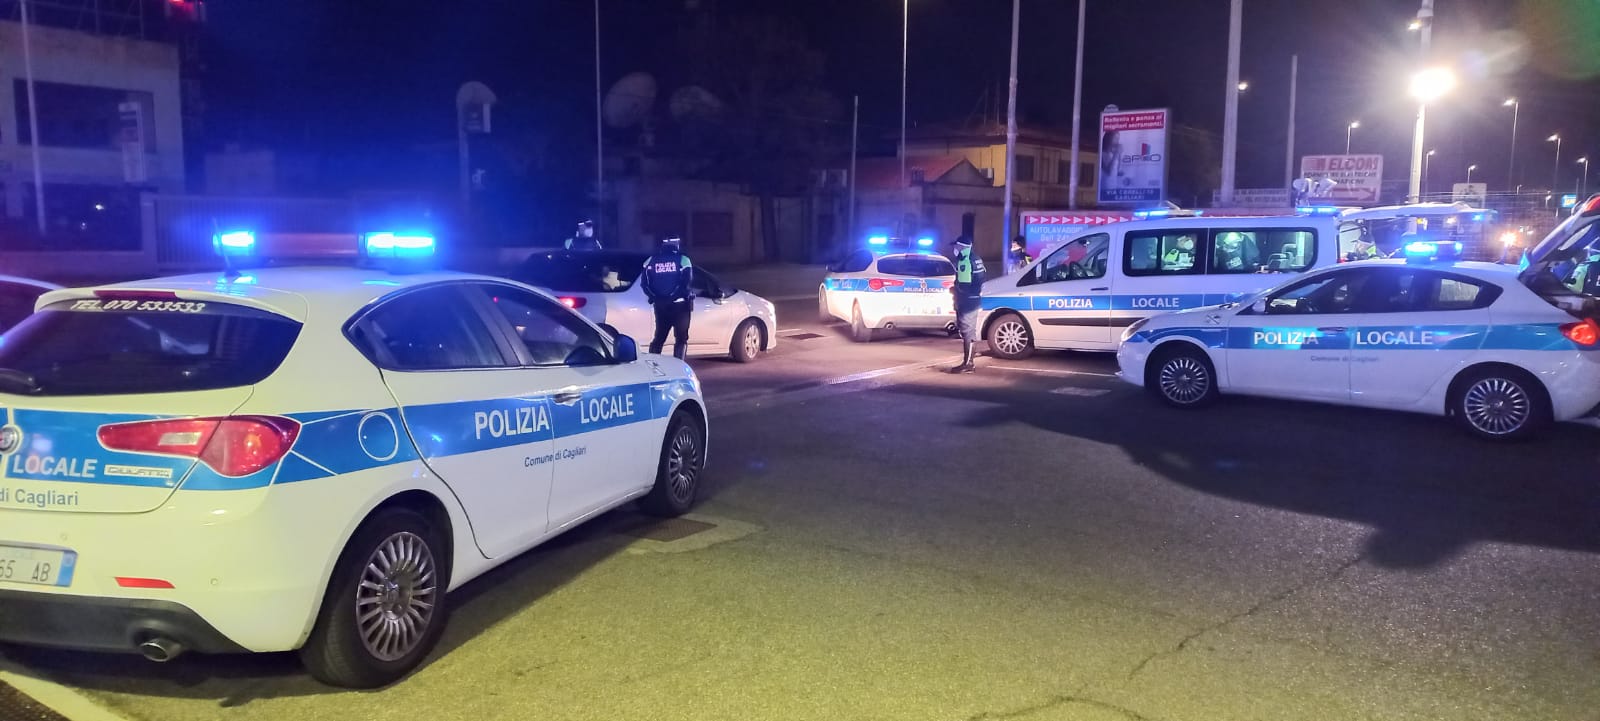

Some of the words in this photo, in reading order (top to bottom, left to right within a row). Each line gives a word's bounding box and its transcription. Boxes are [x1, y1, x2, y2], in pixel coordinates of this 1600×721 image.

[1328, 157, 1378, 170] ELCOM
[137, 301, 206, 312] 533533
[1049, 299, 1094, 309] POLIZIA
[1132, 298, 1180, 308] LOCALE
[1254, 332, 1320, 345] POLIZIA
[1356, 331, 1433, 345] LOCALE
[474, 405, 550, 440] POLIZIA
[580, 393, 634, 424] LOCALE
[12, 454, 98, 478] LOCALE
[524, 454, 553, 468] Comune
[554, 450, 562, 460] di
[562, 446, 586, 459] Cagliari
[15, 488, 78, 508] Cagliari
[32, 562, 51, 582] AB
